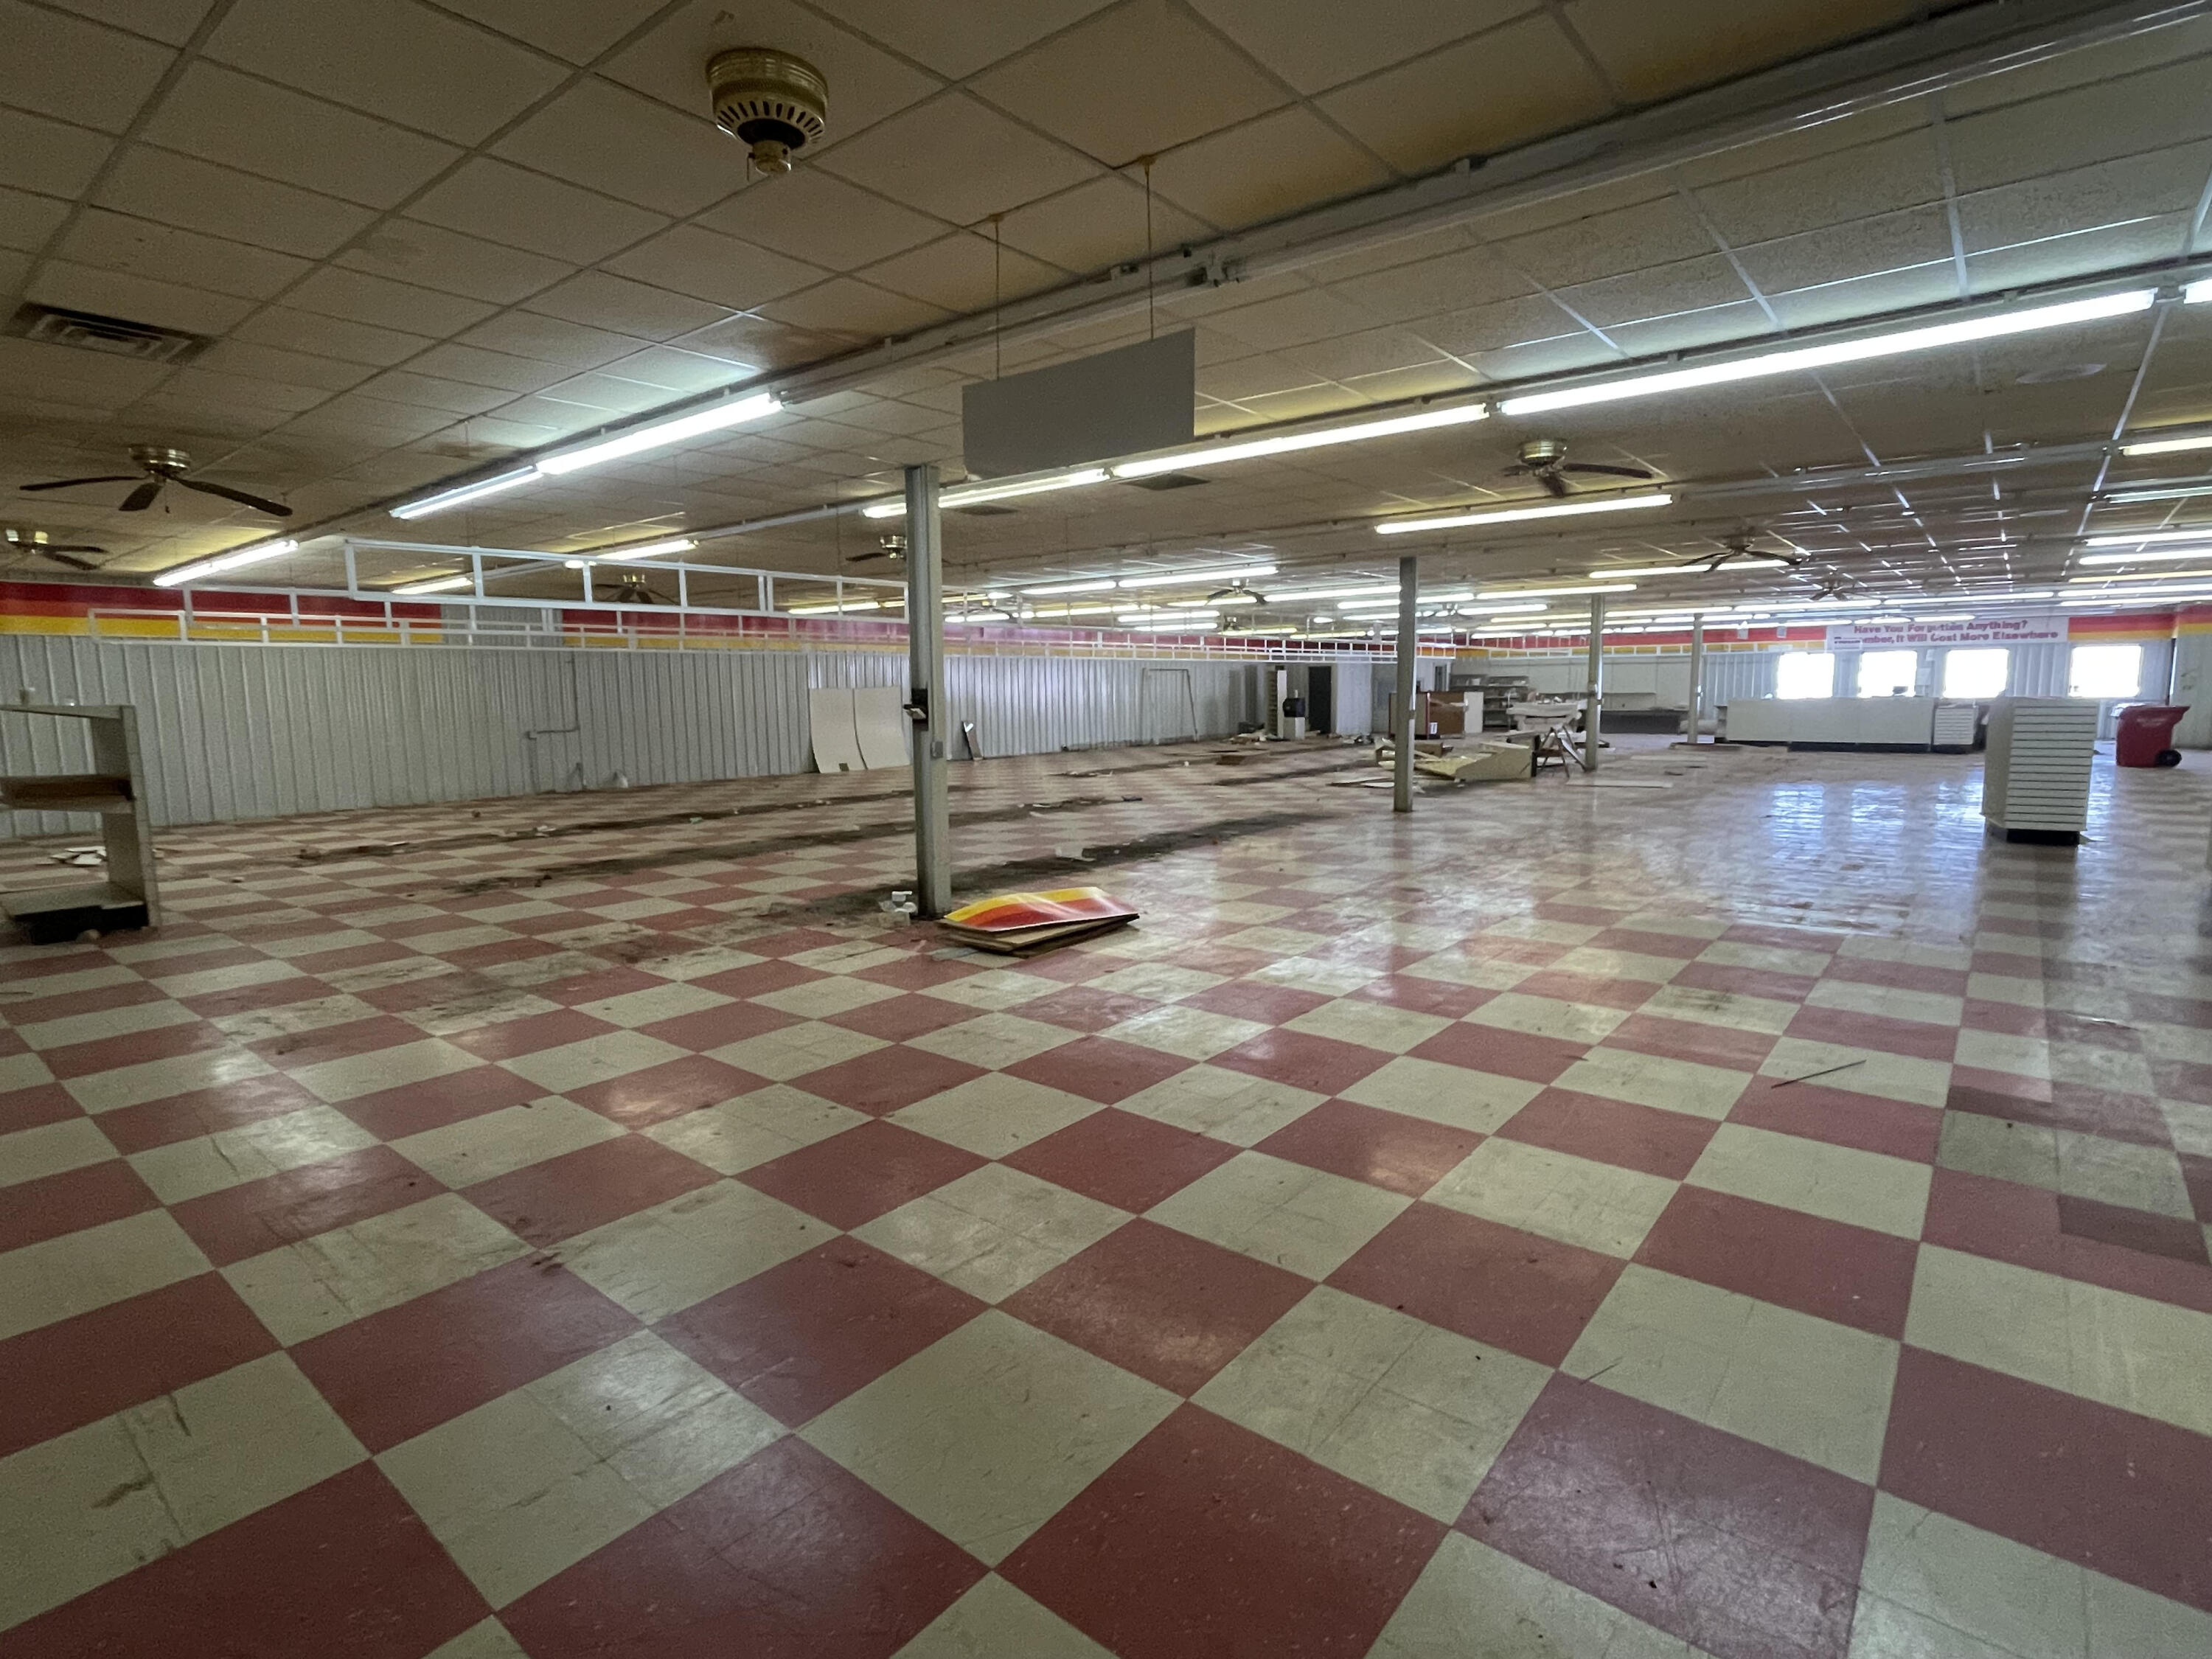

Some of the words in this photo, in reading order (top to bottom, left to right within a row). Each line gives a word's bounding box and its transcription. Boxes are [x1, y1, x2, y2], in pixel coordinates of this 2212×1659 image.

[1966, 620, 2028, 630] Anything?
[1834, 636, 1894, 644] mber,
[1907, 633, 1927, 641] Will
[1930, 633, 1957, 641] Cost
[1993, 631, 2058, 639] Elsewhere
